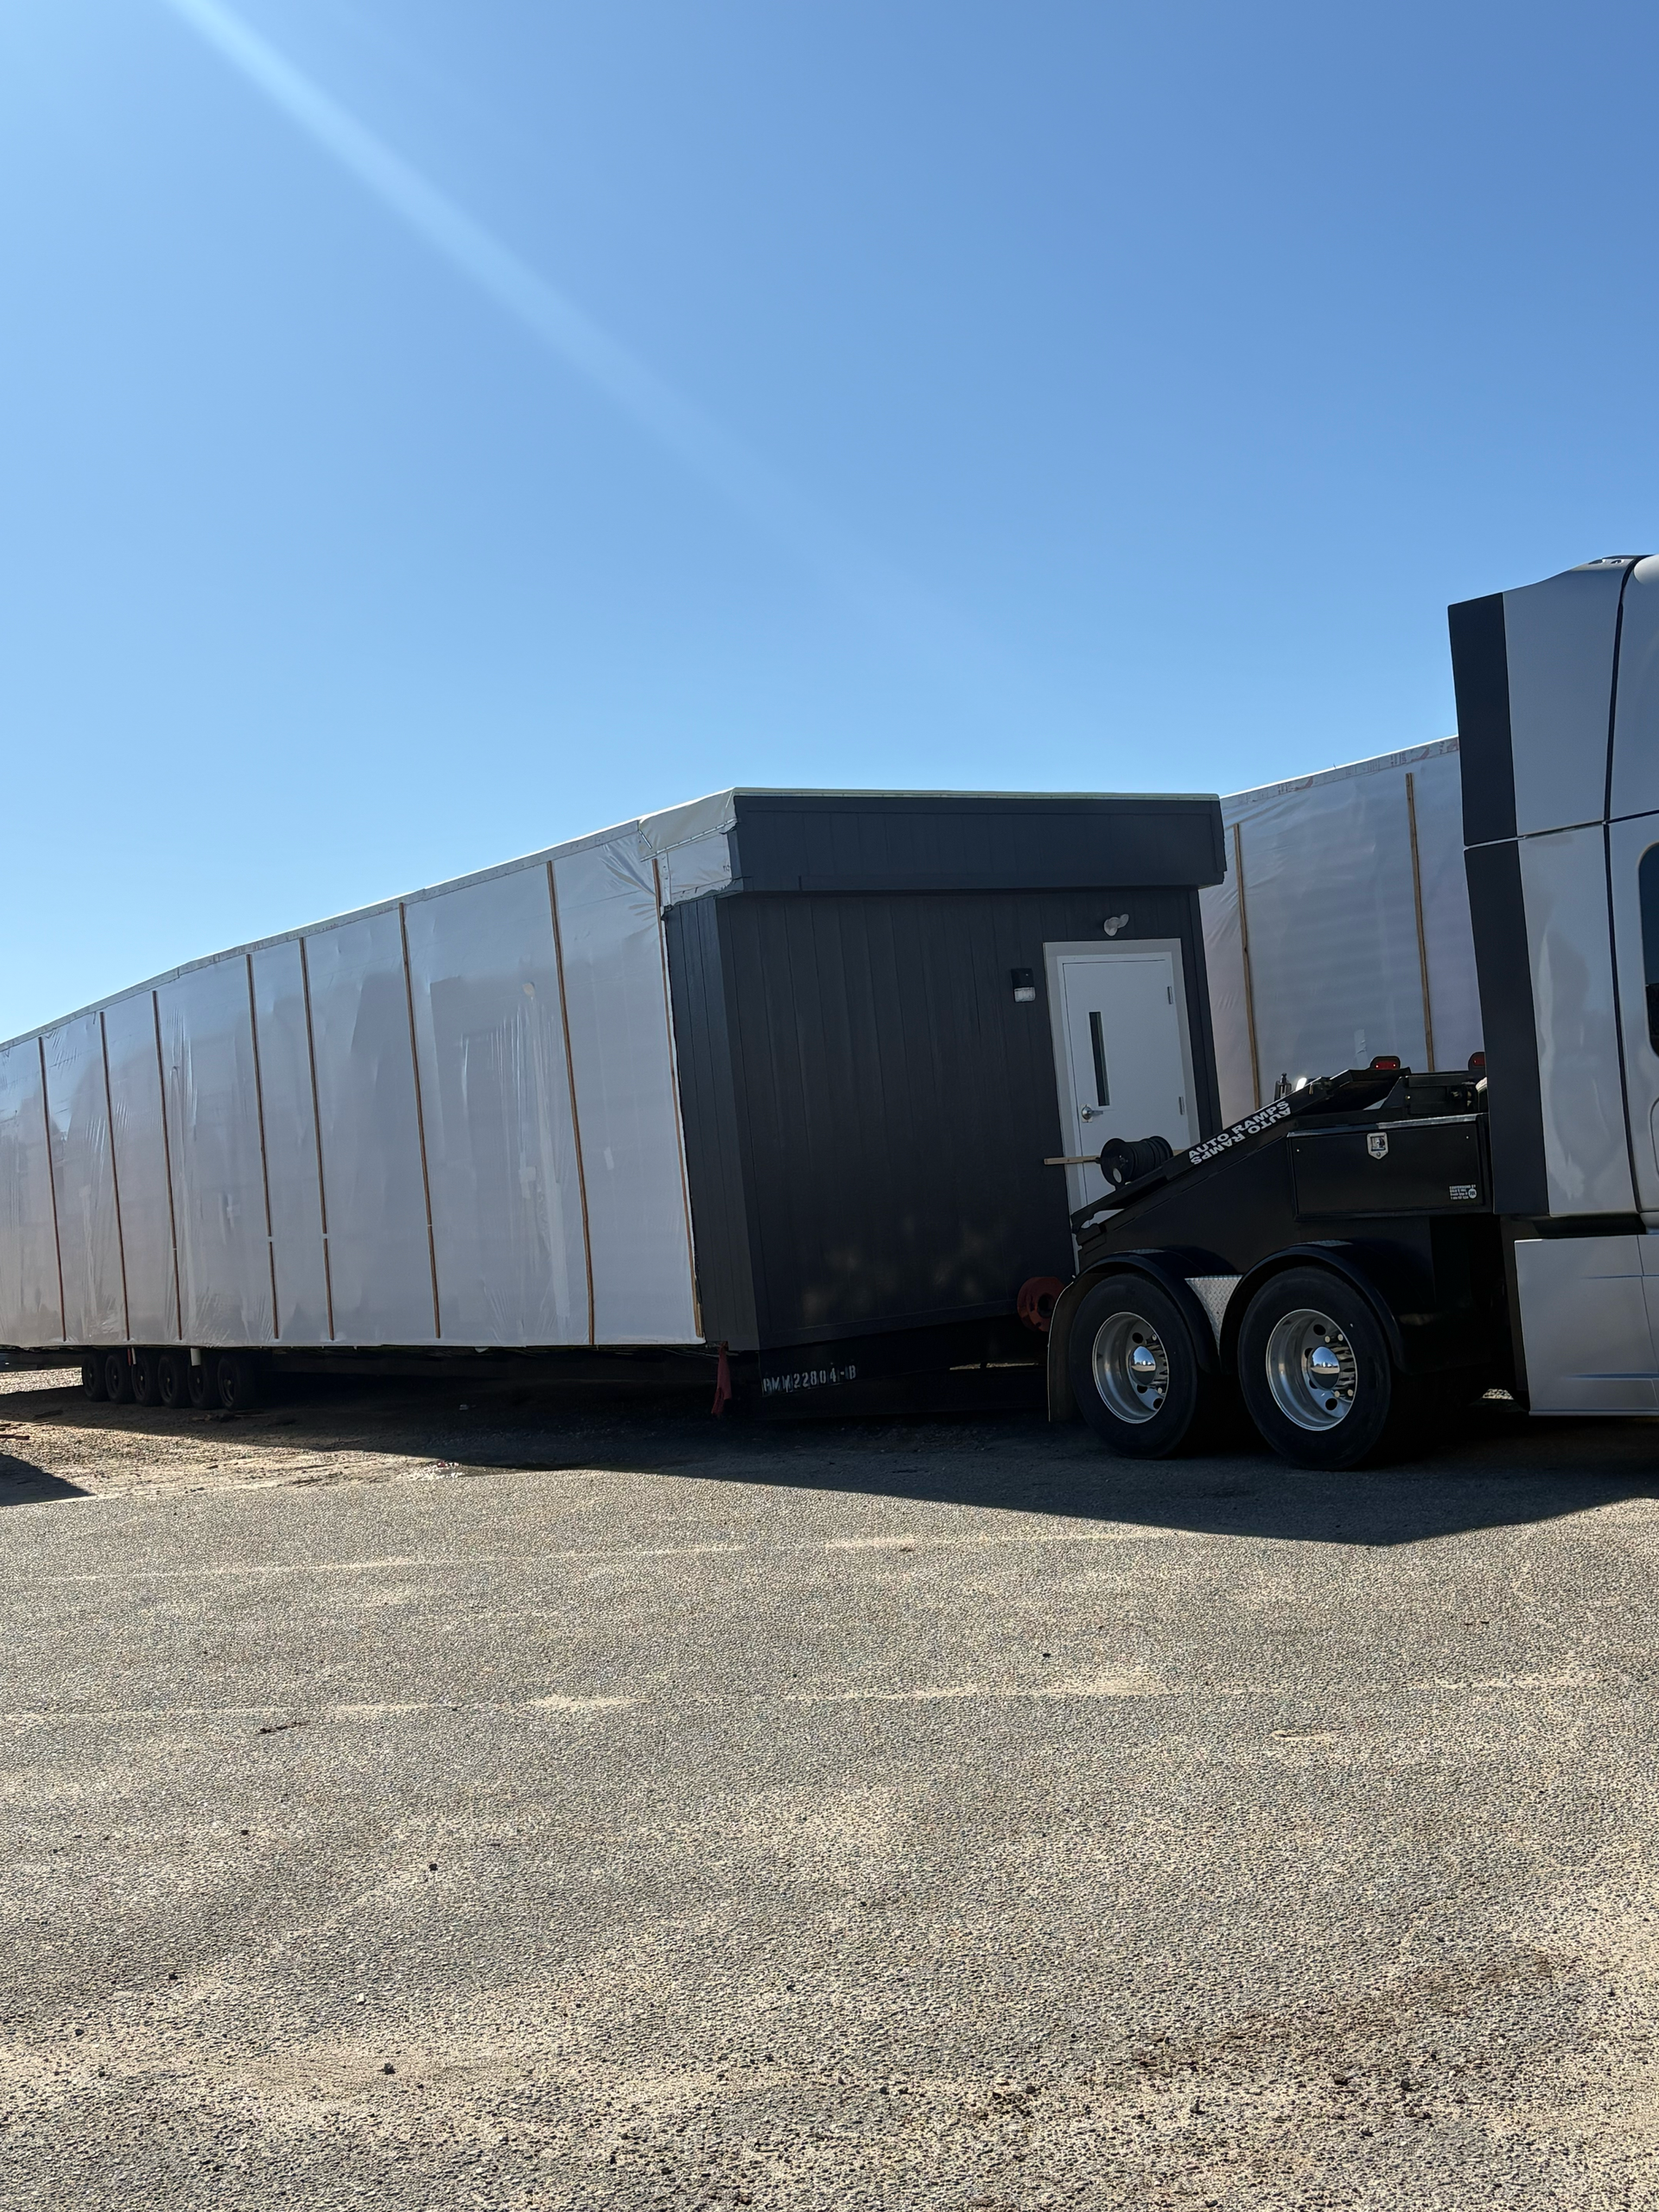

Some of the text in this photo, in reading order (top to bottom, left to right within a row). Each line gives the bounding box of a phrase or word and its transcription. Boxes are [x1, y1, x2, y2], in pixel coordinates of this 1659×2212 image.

[1188, 1101, 1289, 1160] AUTO RAMPS
[1191, 1107, 1291, 1165] AUTO RAMPS
